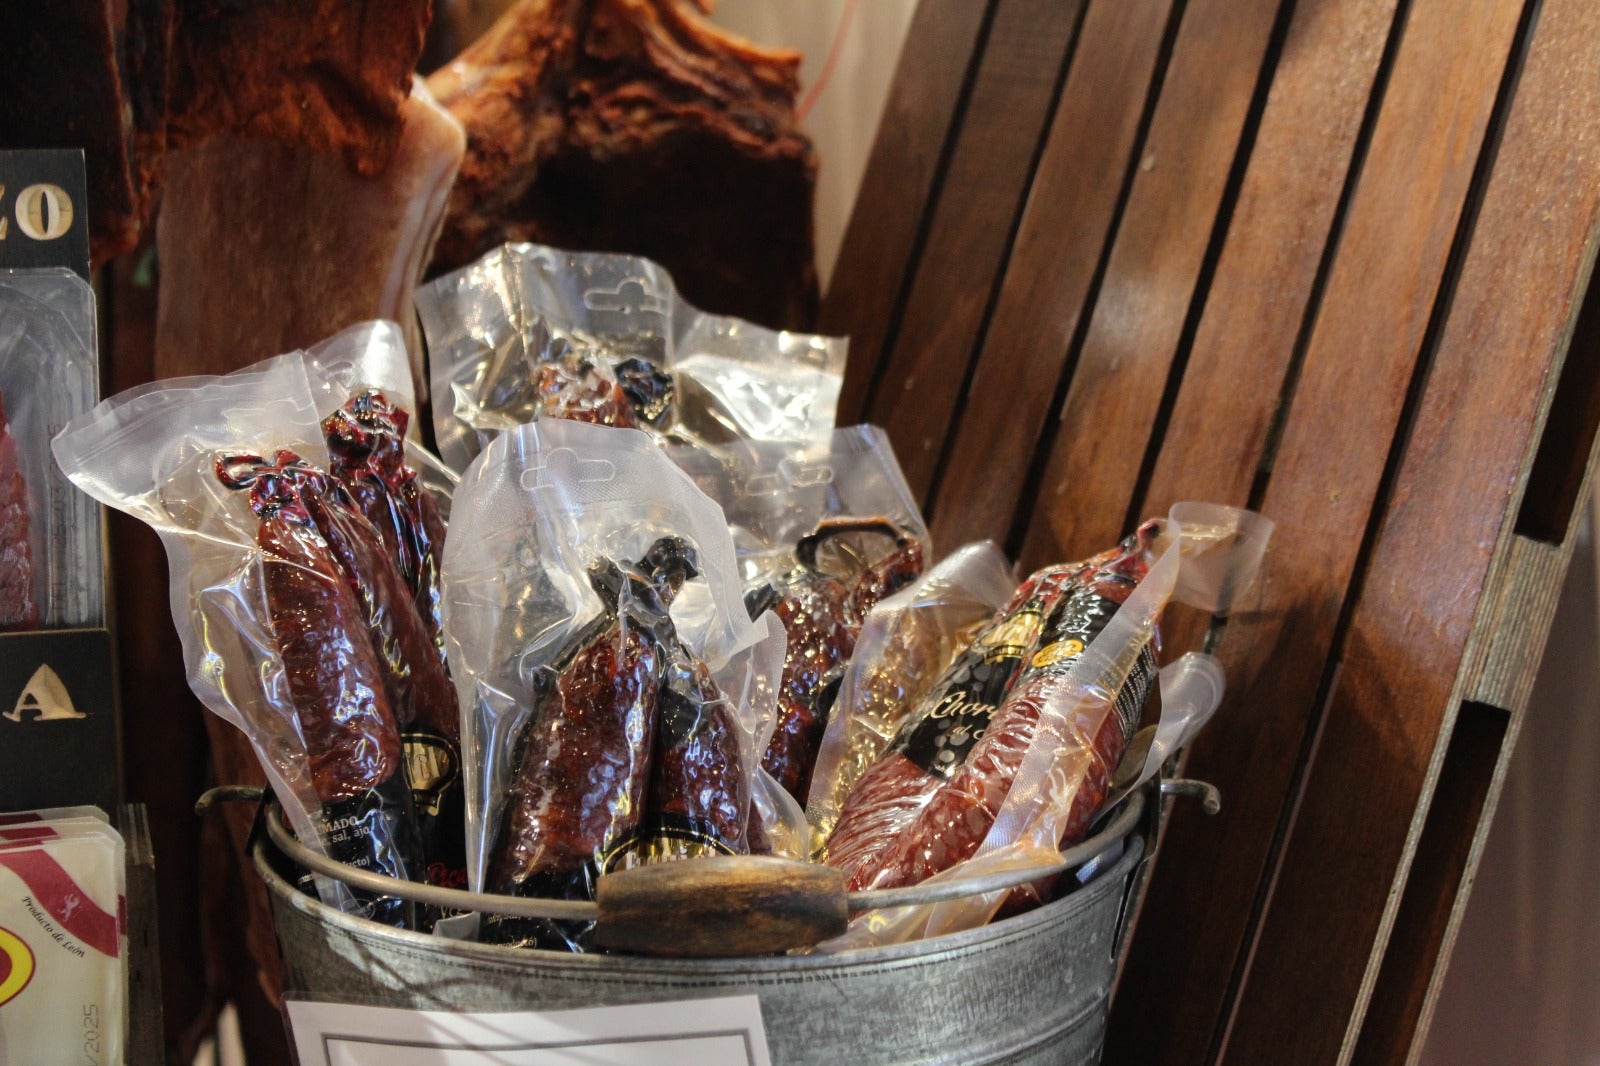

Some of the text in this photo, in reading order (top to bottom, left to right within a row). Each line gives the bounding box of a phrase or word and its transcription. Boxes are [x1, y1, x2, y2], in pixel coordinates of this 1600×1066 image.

[0, 183, 74, 241] O
[353, 825, 370, 839] ajo
[22, 895, 86, 958] Producto de León
